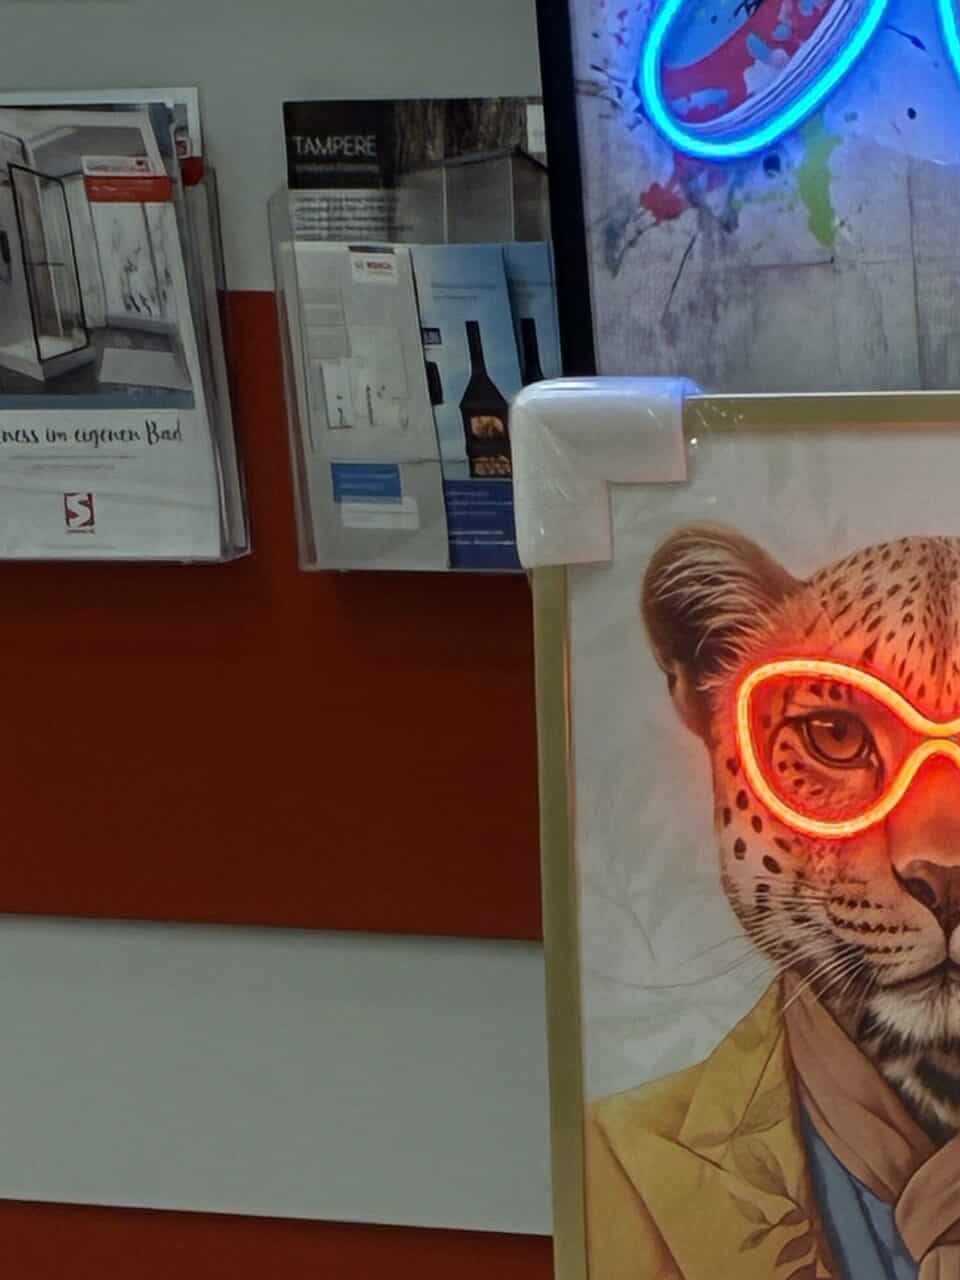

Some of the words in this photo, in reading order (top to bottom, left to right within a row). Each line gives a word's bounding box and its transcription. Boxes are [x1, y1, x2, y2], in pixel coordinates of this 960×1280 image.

[292, 134, 377, 157] TAMPERE
[0, 427, 39, 445] ness
[74, 427, 141, 448] eigenen
[145, 417, 184, 446] Bad
